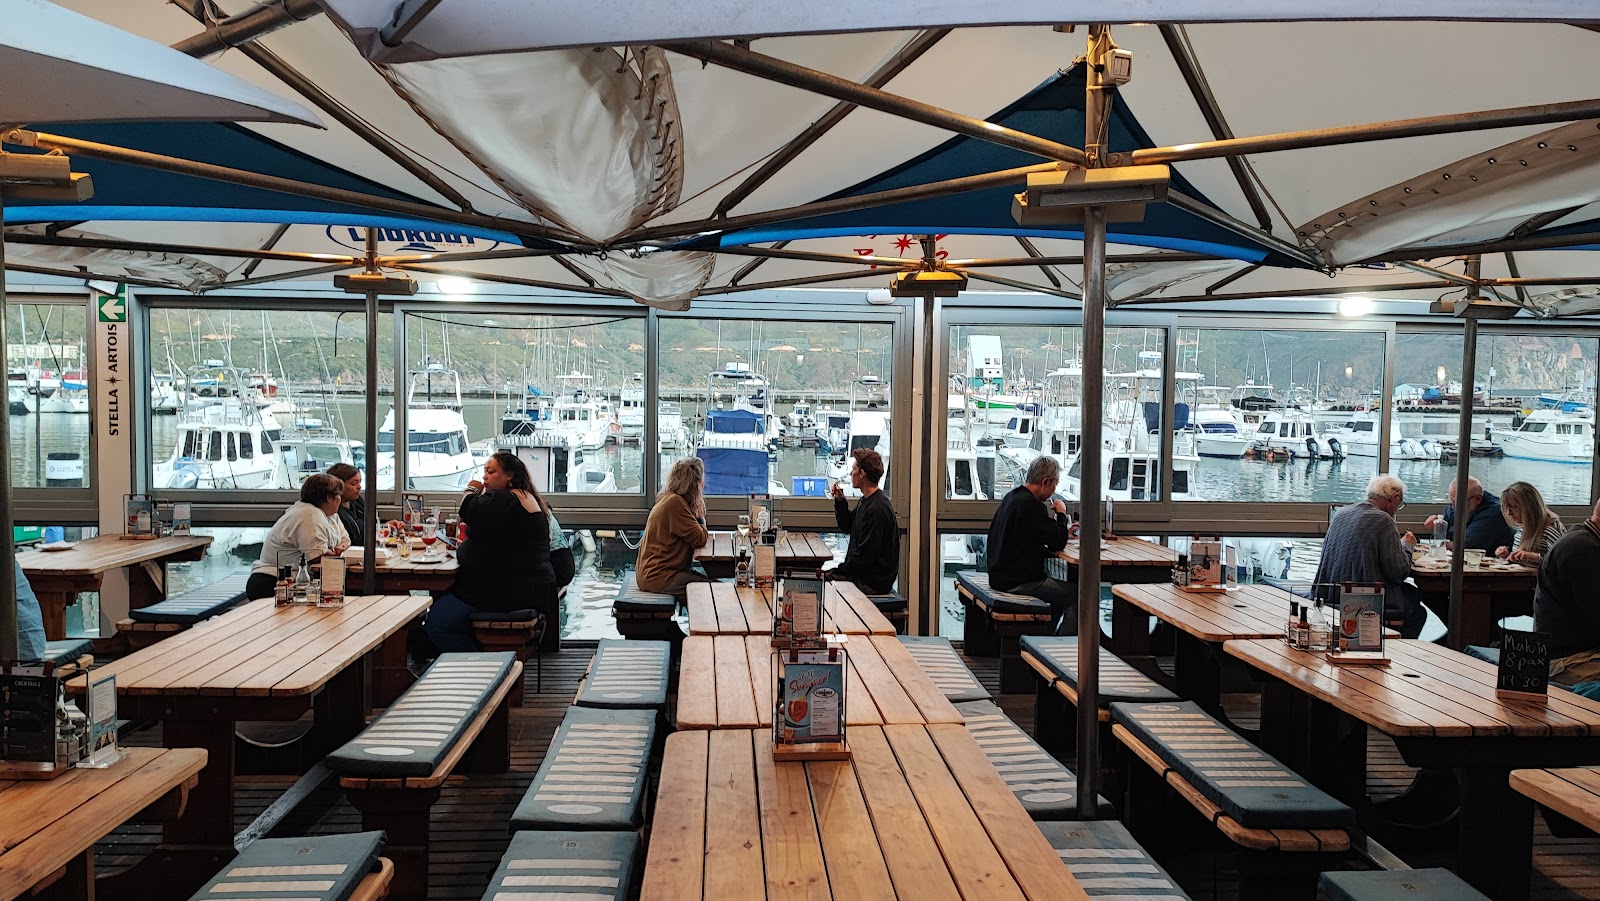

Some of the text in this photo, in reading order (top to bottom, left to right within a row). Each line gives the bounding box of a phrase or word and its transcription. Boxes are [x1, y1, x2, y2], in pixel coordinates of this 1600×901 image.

[107, 323, 119, 437] STELLA ARTOIS
[1504, 633, 1547, 656] Malvin
[1505, 652, 1545, 671] 8 pax
[14, 680, 41, 688] COCKTAILS
